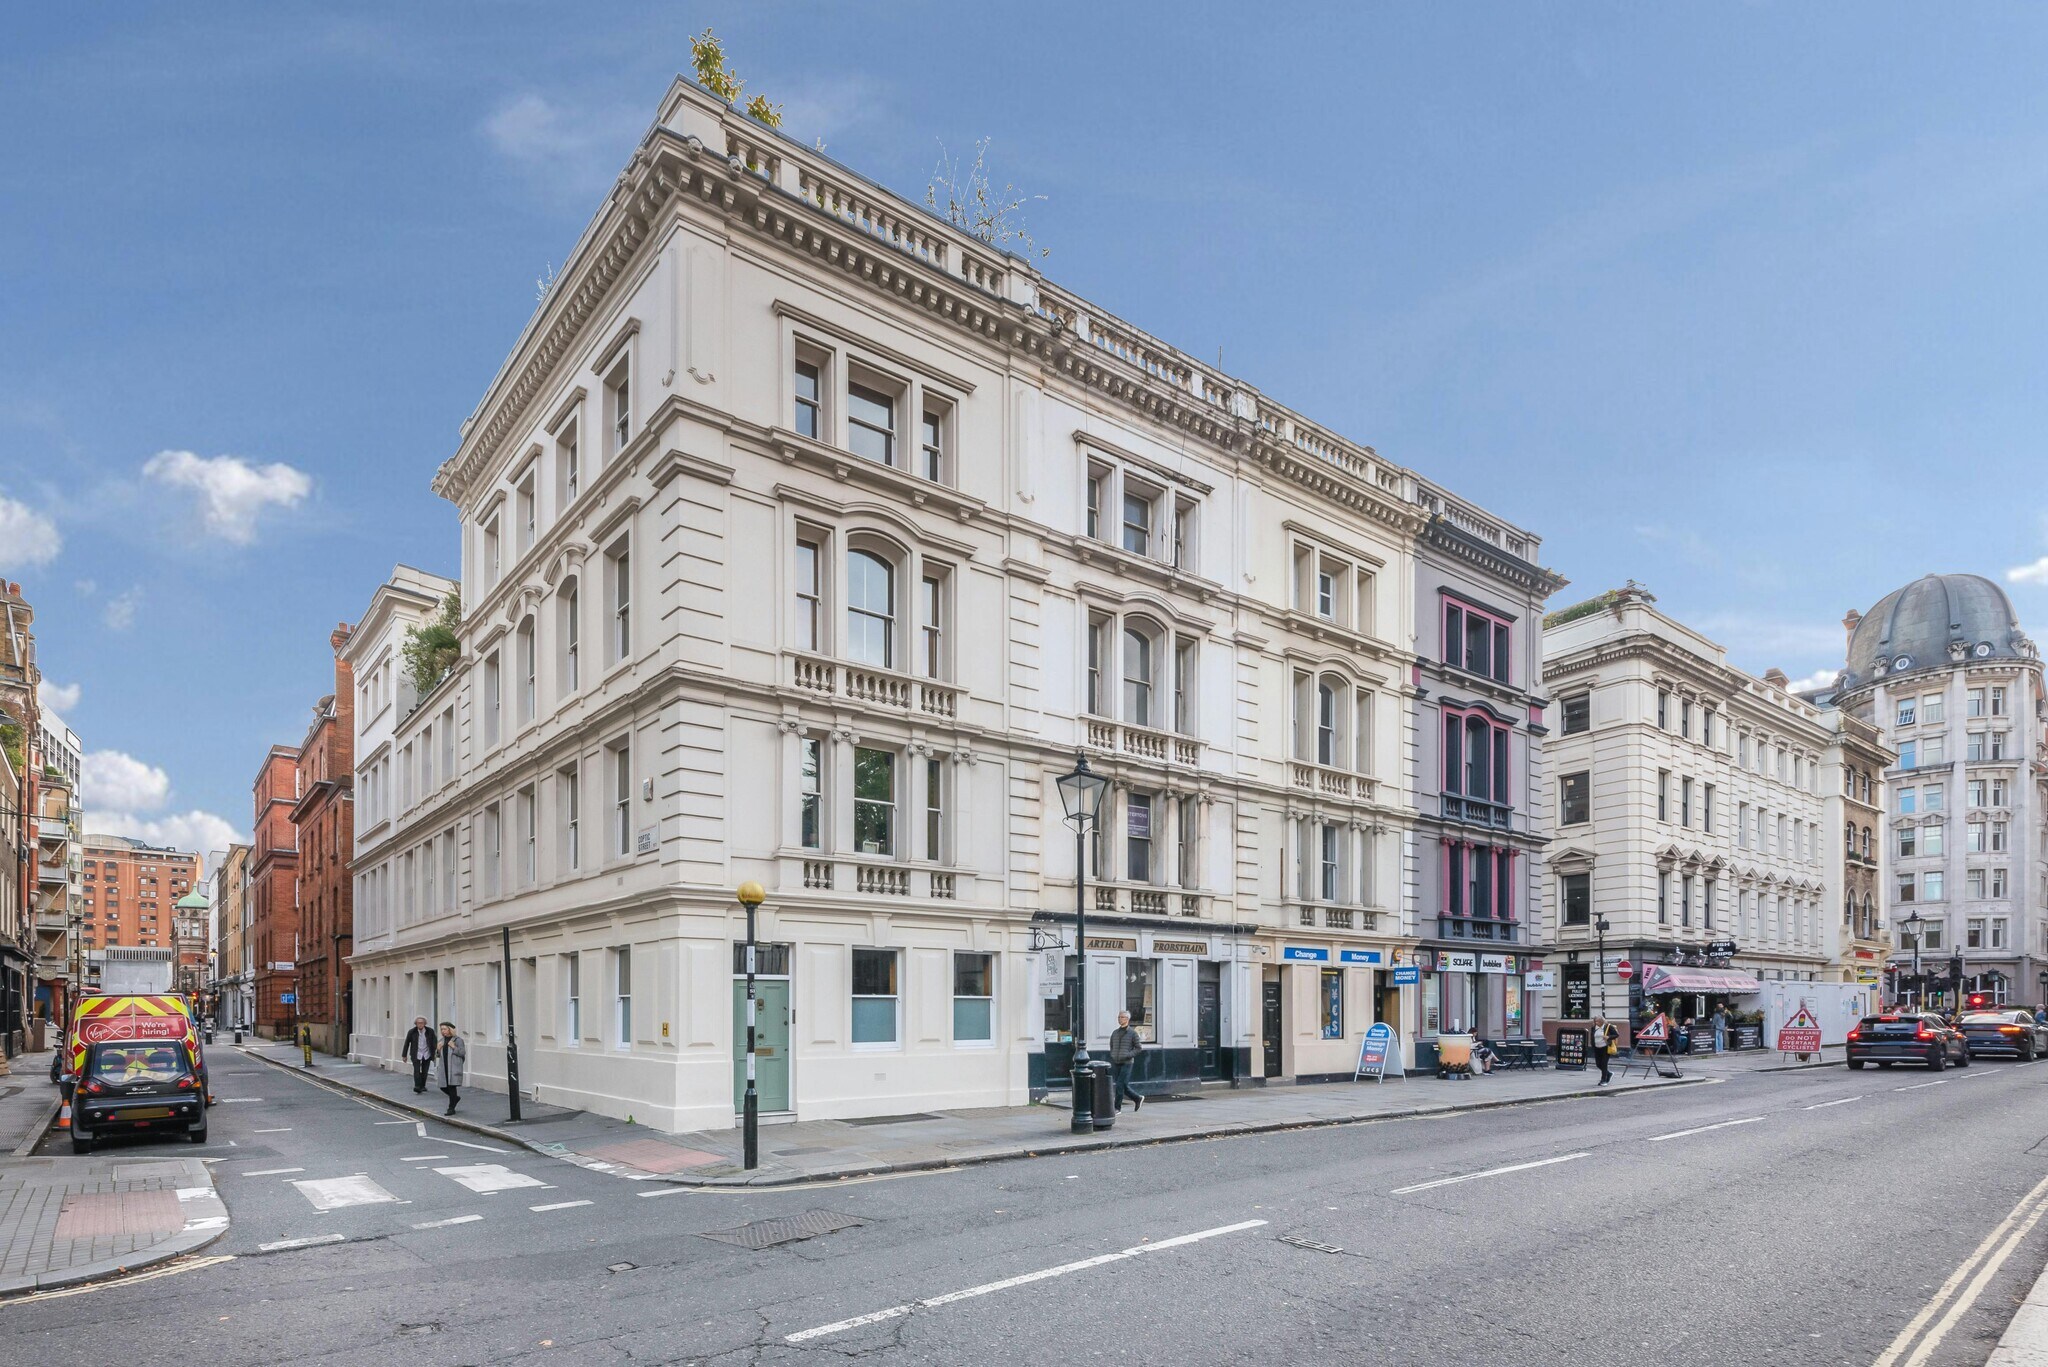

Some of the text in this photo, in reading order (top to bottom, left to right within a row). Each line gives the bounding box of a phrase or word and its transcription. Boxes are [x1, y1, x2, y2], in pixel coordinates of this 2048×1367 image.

[638, 833, 651, 844] COPTIC
[638, 840, 651, 852] STREET
[1087, 939, 1124, 949] ARTHUR
[1153, 942, 1204, 953] PROBSTHAIN
[1294, 950, 1318, 960] Change
[1351, 953, 1370, 962] Money
[1482, 959, 1502, 969] bubbles
[90, 1026, 110, 1039] Virgin
[142, 1028, 170, 1036] hiring!
